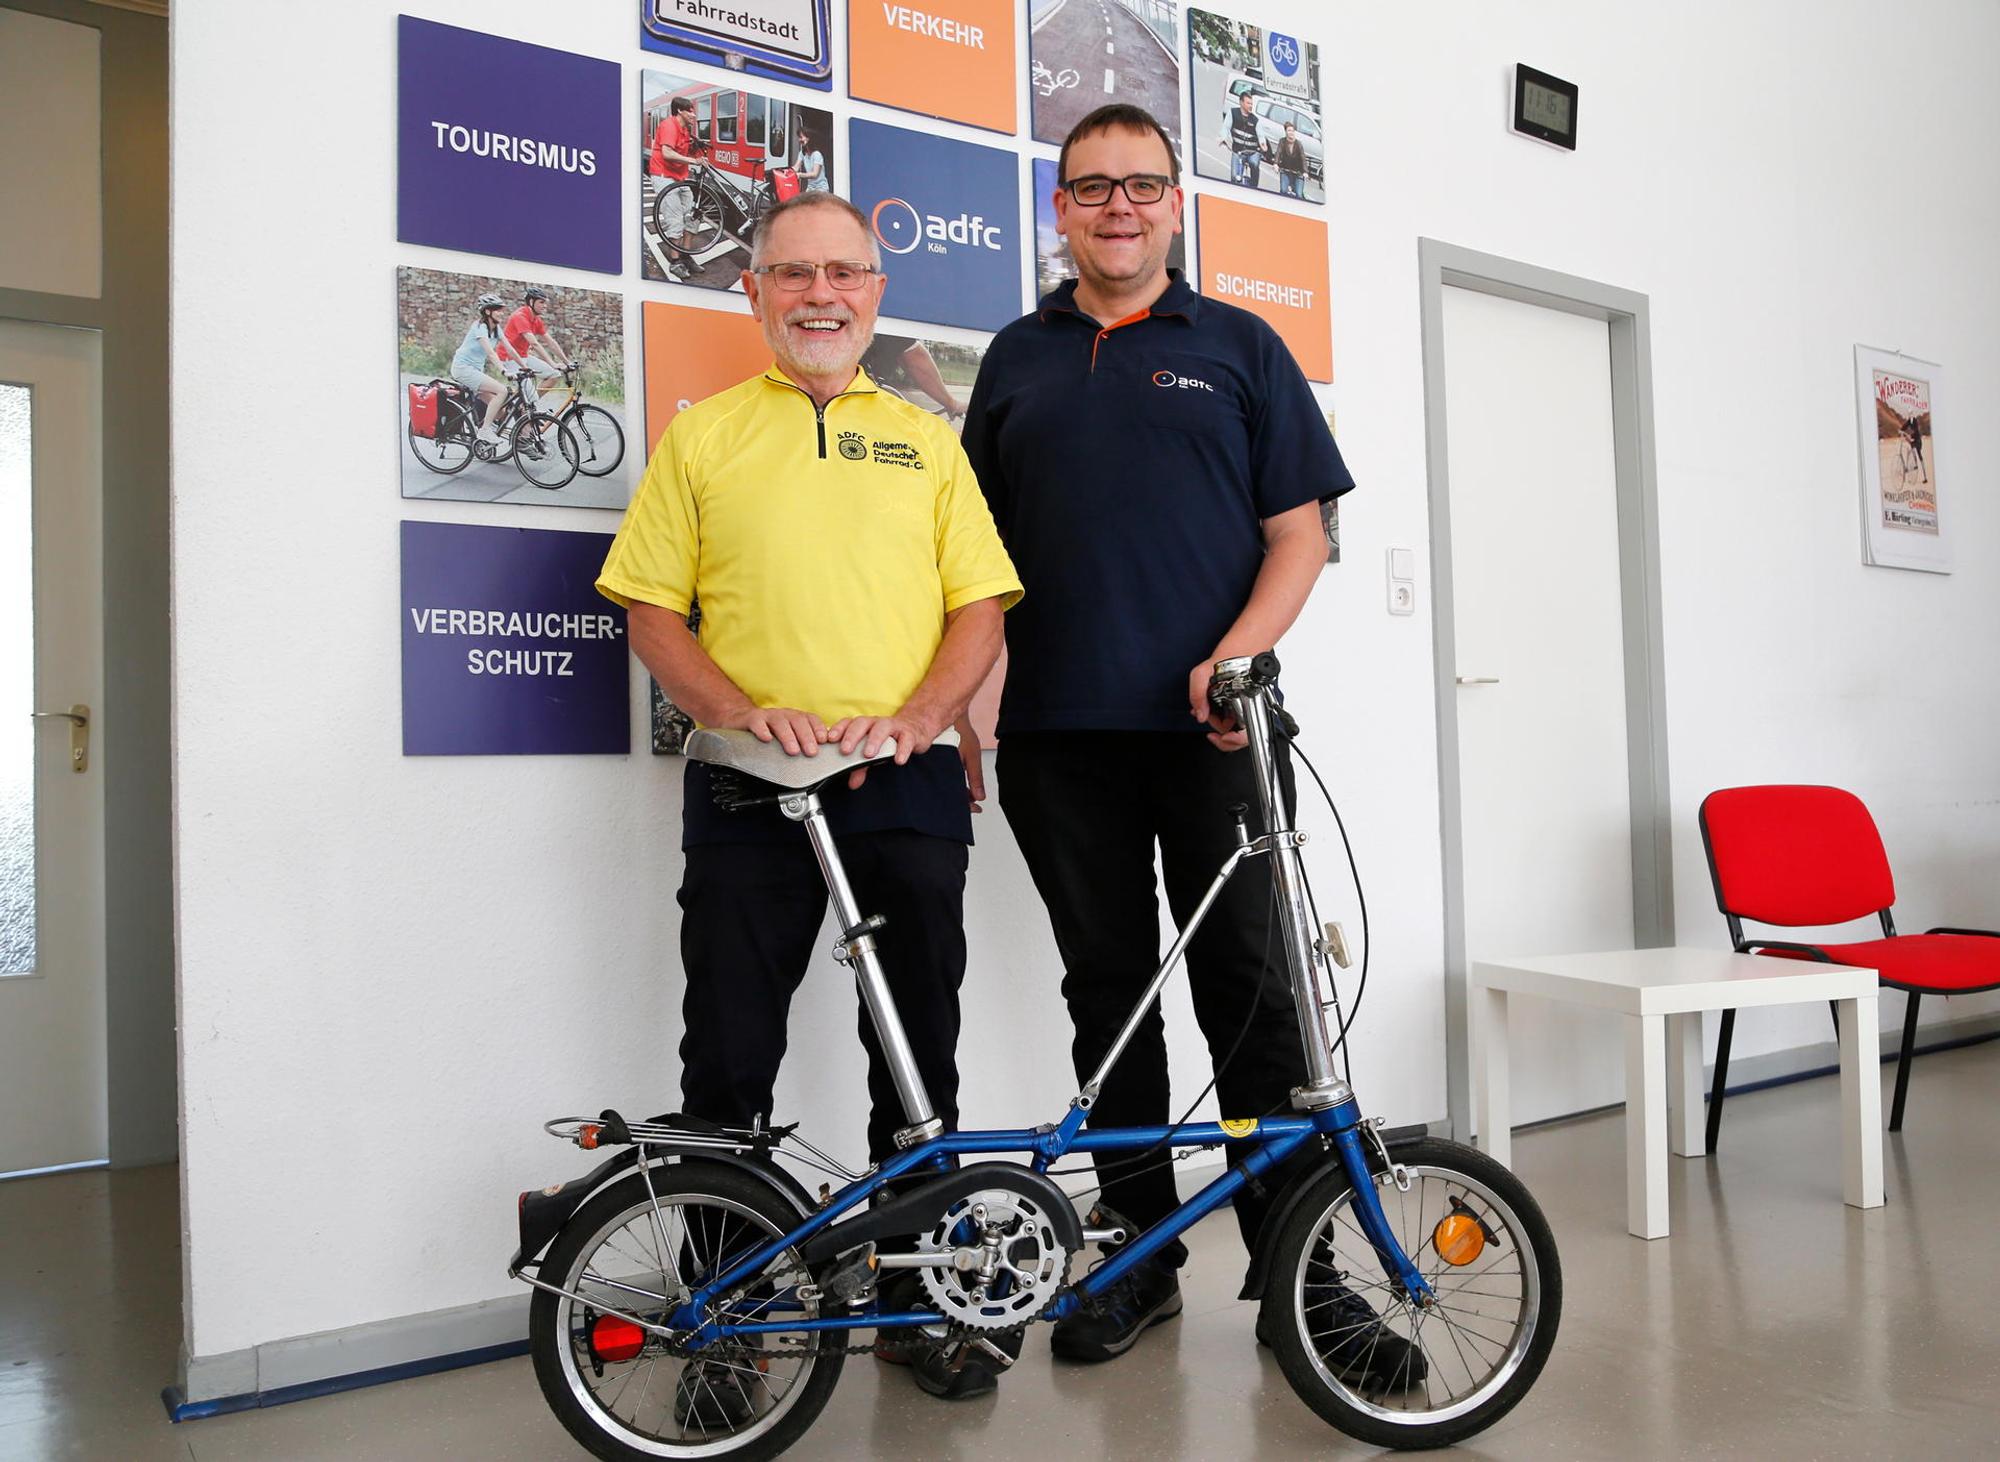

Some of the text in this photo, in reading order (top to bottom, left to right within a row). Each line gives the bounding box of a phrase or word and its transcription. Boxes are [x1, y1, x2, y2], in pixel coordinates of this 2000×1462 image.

[676, 0, 799, 40] Fahrradstadt
[883, 2, 985, 50] VERKEHR
[431, 121, 597, 176] TOURISMUS
[925, 213, 1001, 251] adfc
[927, 242, 948, 255] Köln
[1215, 272, 1314, 310] SICHERHEIT
[837, 431, 866, 442] ADFC
[411, 608, 623, 640] VERBRAUCHER-
[467, 649, 574, 676] SCHUTZ
